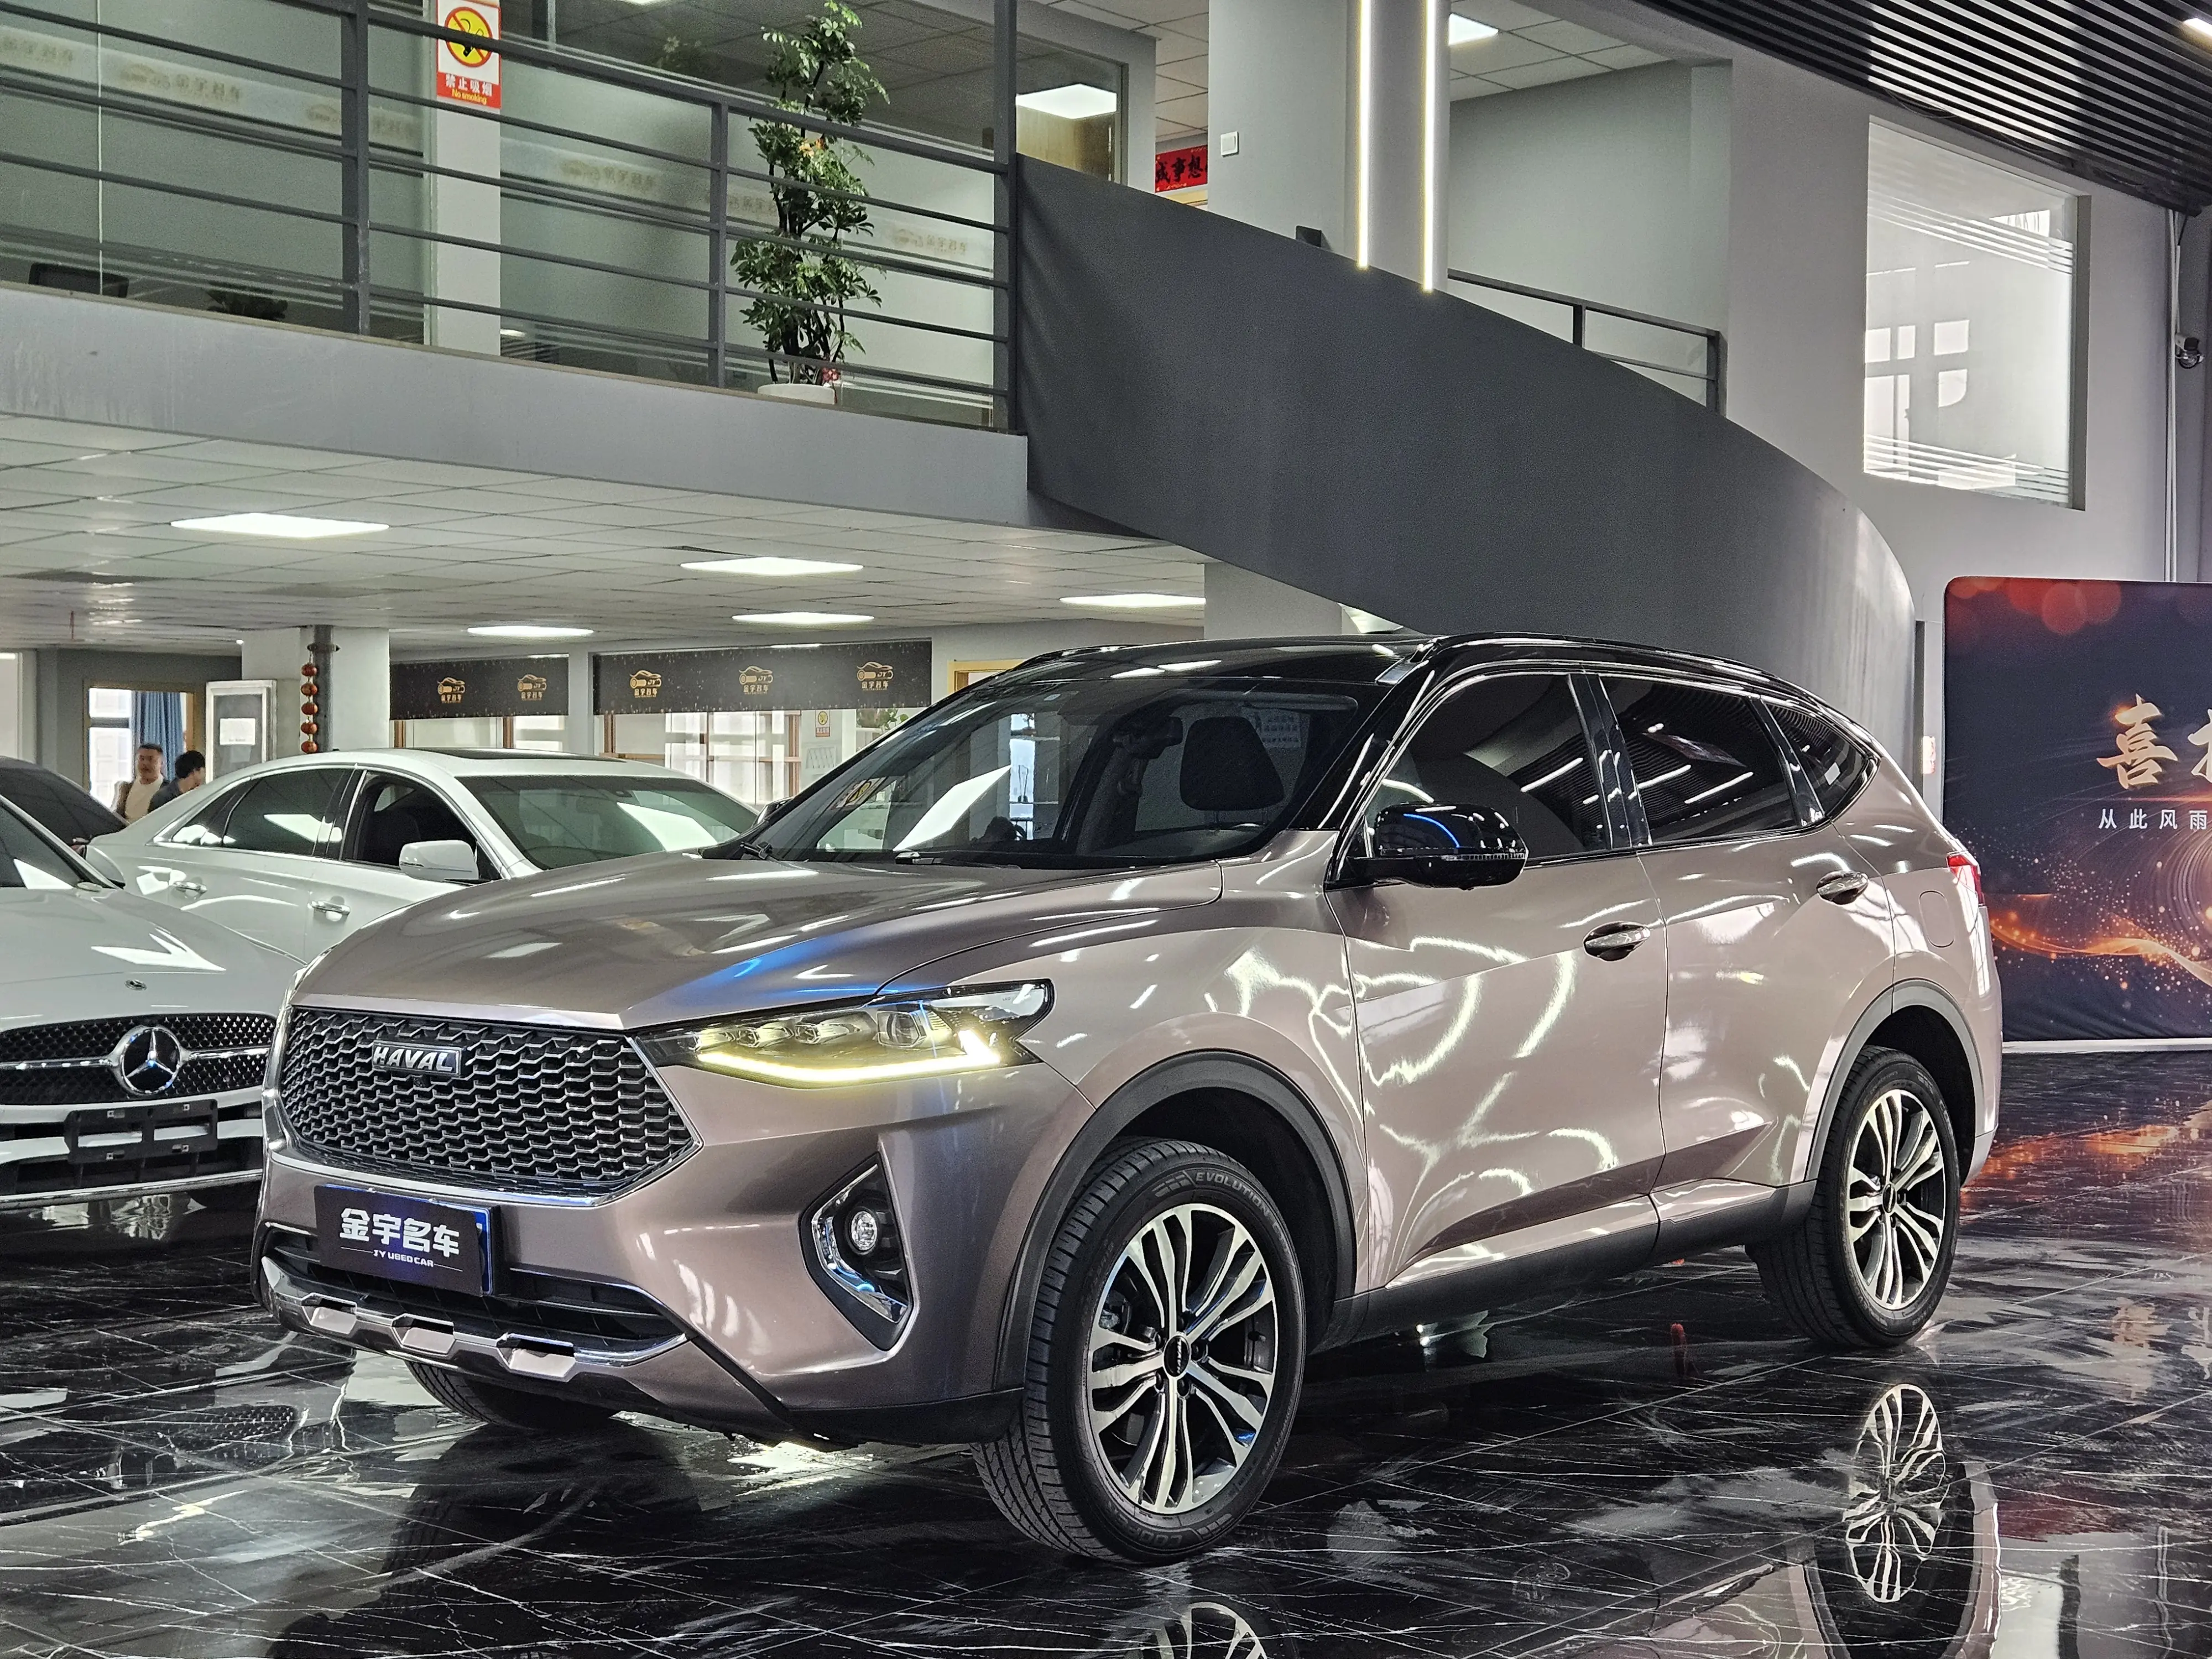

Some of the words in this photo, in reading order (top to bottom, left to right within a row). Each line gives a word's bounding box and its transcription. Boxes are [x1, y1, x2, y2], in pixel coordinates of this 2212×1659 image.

[446, 73, 492, 97] 禁止吸烟
[452, 88, 461, 98] No
[462, 93, 487, 105] smoking
[2099, 808, 2208, 830] 从此风雨
[373, 1046, 453, 1072] HAVAL
[1196, 1172, 1271, 1217] EVOLUTION
[340, 1208, 460, 1258] 金宇名车
[373, 1249, 387, 1258] JY
[388, 1252, 413, 1264] USED
[414, 1256, 434, 1267] CAR
